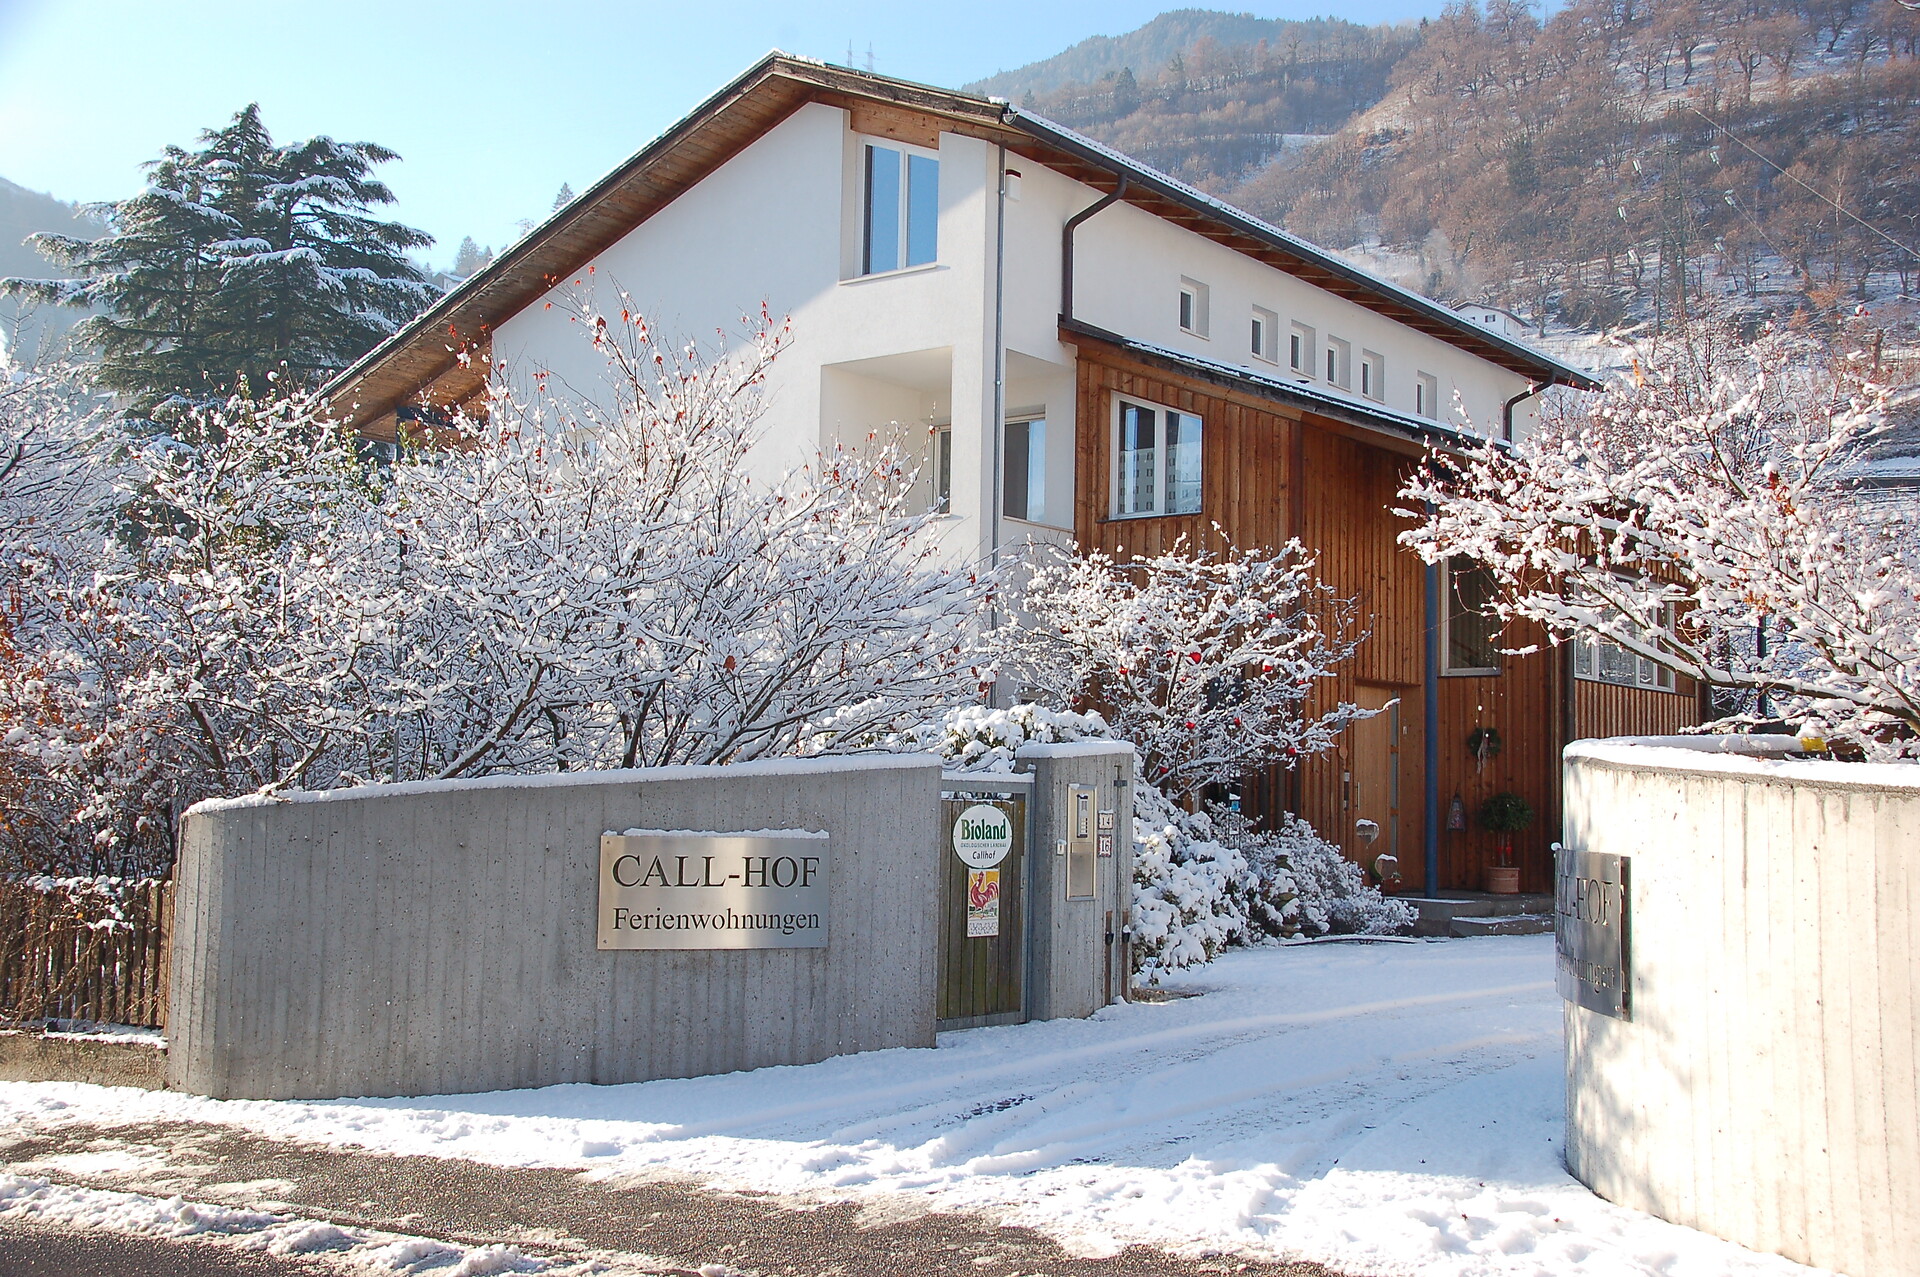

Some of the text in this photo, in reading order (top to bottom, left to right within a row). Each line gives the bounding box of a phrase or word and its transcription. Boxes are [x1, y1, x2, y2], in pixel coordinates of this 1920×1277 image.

[961, 818, 1006, 840] Bioland
[972, 850, 996, 860] Callhof
[1101, 838, 1110, 852] 16
[612, 855, 820, 888] CALL-HOF
[1557, 873, 1613, 926] LL-HOF
[612, 907, 820, 935] Ferienwohnungen
